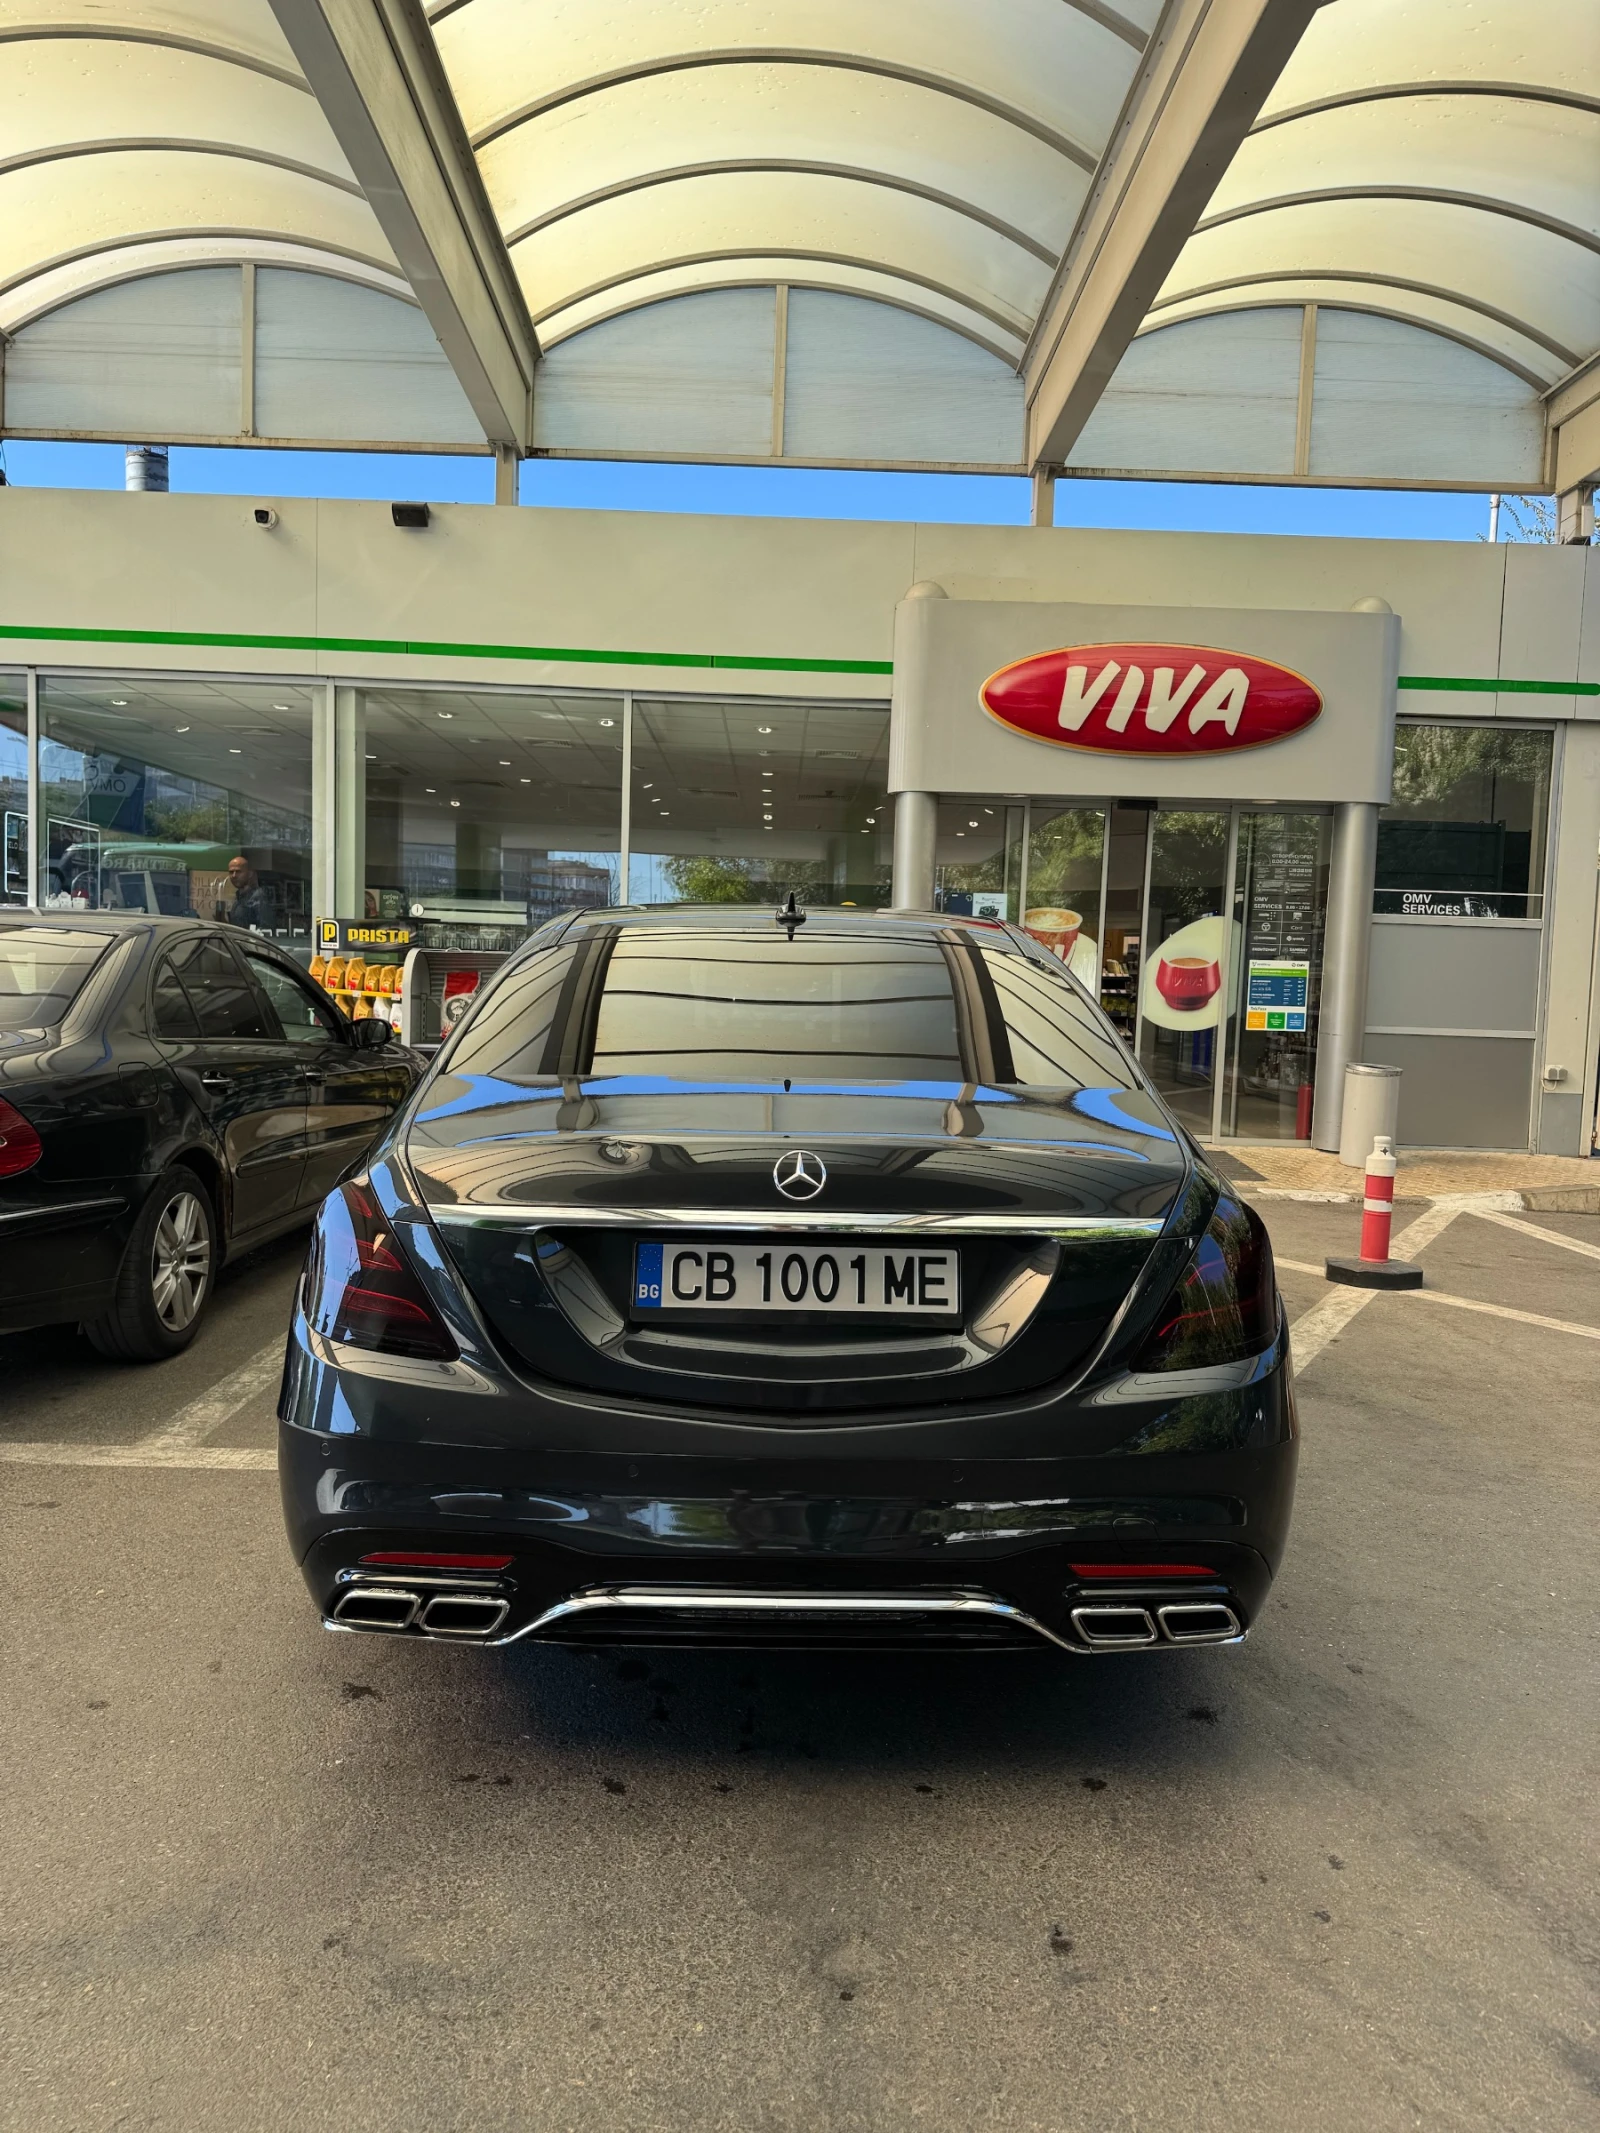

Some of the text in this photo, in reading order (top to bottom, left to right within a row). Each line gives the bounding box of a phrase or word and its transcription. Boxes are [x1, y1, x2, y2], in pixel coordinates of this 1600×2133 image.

[1058, 660, 1250, 736] VIVA
[1402, 893, 1432, 904] OMV
[1402, 903, 1460, 916] SERVICES
[347, 928, 411, 944] PRISTA
[671, 1250, 949, 1306] CB 1001 ME
[638, 1283, 660, 1299] BG
